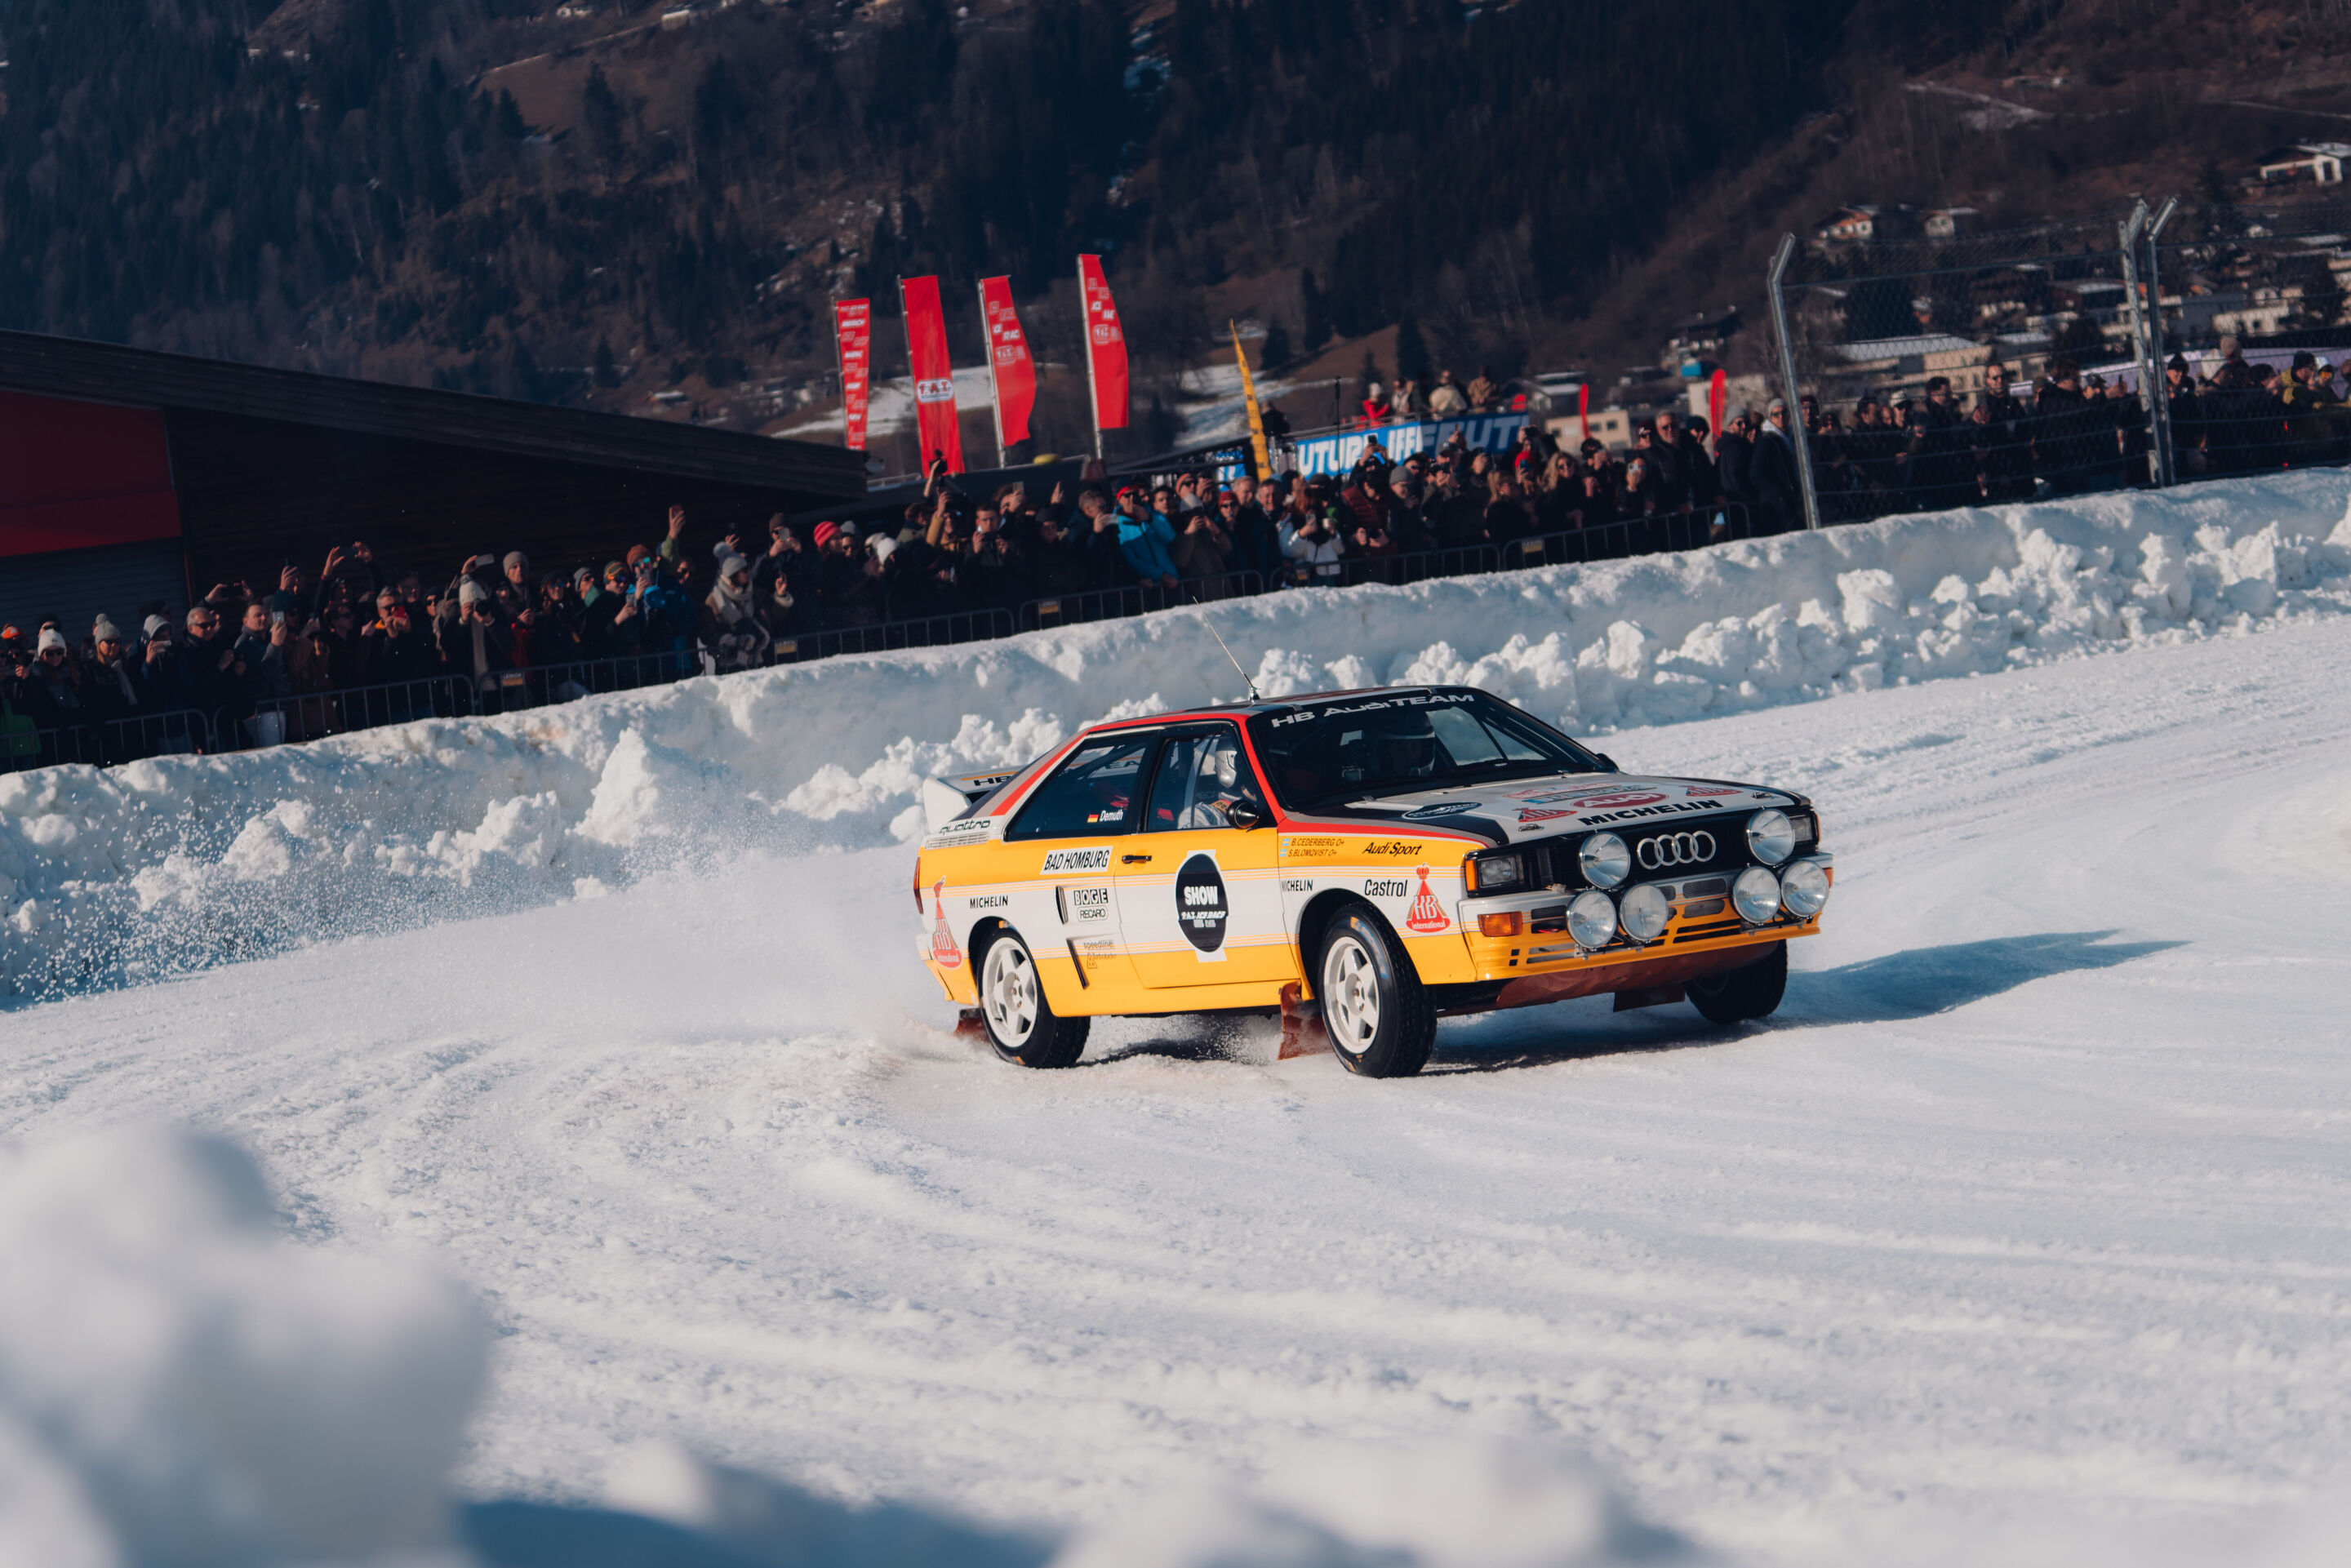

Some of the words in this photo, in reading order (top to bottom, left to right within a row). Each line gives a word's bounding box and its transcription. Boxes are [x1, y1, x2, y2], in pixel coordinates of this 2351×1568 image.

[1271, 711, 1316, 728] HB
[1583, 792, 1660, 806] AUDI
[1099, 810, 1124, 823] Demuth
[1577, 799, 1724, 826] MICHELIN
[939, 820, 991, 835] quattro
[1362, 842, 1389, 855] Audi
[1389, 842, 1422, 857] Sport
[1044, 853, 1063, 872] BAD
[1063, 849, 1110, 869] HOMBURG
[1073, 888, 1109, 905] BOGE
[1184, 886, 1219, 906] SHOW
[1364, 879, 1408, 897] Castrol
[970, 895, 1009, 909] MICHELIN
[1414, 895, 1438, 919] HB
[1080, 907, 1106, 919] RECARO
